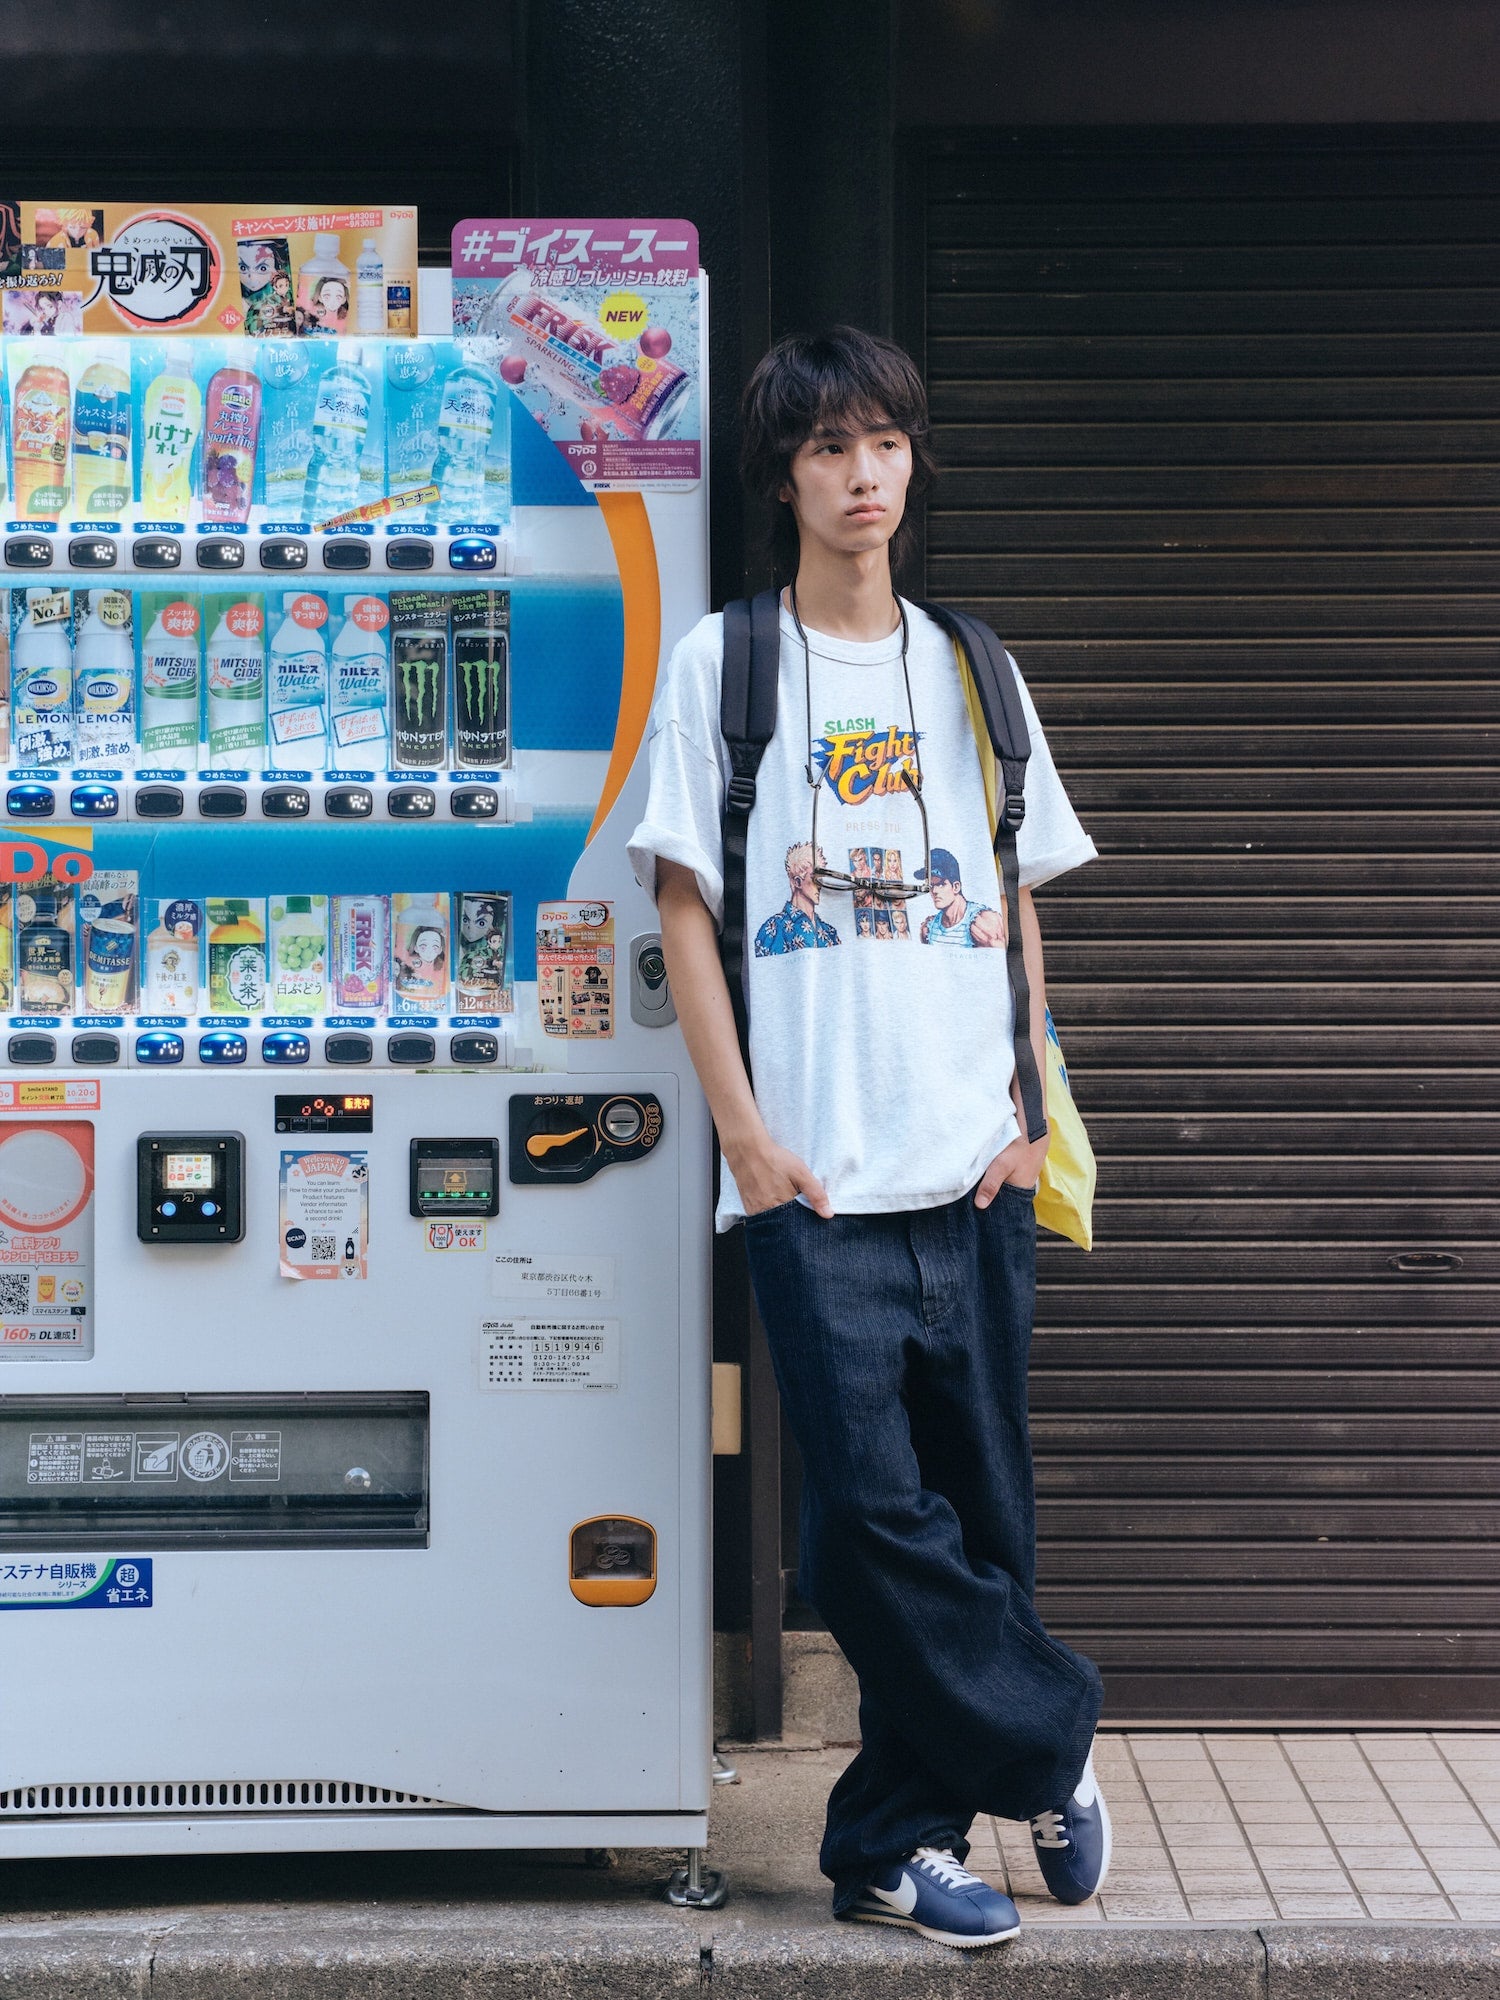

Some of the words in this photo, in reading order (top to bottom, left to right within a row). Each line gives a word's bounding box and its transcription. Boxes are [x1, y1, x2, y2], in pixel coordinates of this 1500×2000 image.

[390, 211, 414, 219] DyDo
[234, 214, 335, 235] キャンペーン実施中!
[123, 236, 194, 246] きめつのやいば
[461, 227, 689, 264] #ゴイスースー
[80, 246, 210, 309] 鬼滅の刃
[531, 268, 689, 287] 冷感リフレッシュ飲料
[606, 310, 644, 323] NEW
[518, 298, 618, 367] FRISK
[269, 351, 299, 363] 自然の
[394, 352, 425, 364] 自然の
[524, 336, 576, 372] SPARKLING
[275, 365, 296, 377] 恵み
[400, 365, 422, 377] 恵み
[319, 397, 366, 417] 天然水
[444, 398, 491, 418] 天然水
[77, 405, 128, 424] ジャスミン茶
[147, 422, 193, 444] バナナ
[207, 430, 255, 450] Sparkling
[271, 418, 286, 479] 澄んだ水
[396, 420, 409, 479] 澄んだ水
[568, 445, 597, 457] DyDo
[395, 491, 434, 508] コーナー
[391, 593, 428, 606] Unleash
[103, 611, 127, 621] No.1
[166, 609, 195, 617] スッキリ
[231, 610, 259, 618] スッキリ
[291, 611, 326, 621] すっきり!
[354, 612, 388, 623] すっきり!
[393, 611, 447, 622] モンスターエナジー
[453, 611, 507, 622] モンスターエナジー
[166, 617, 195, 631] 爽快
[231, 618, 260, 632] 爽快
[154, 656, 197, 668] MITSUYA
[220, 657, 262, 669] MITSUYA
[167, 668, 197, 678] CIDER
[232, 668, 262, 678] CIDER
[278, 664, 319, 674] カルピス
[340, 667, 380, 676] カルピス
[277, 674, 320, 688] Water
[338, 676, 381, 690] Water
[29, 682, 58, 694] WILKINSON
[88, 684, 118, 696] WILKINSON
[18, 713, 70, 724] LEMON
[78, 714, 132, 724] LEMON
[824, 717, 876, 735] SLASH
[396, 729, 445, 744] MONSTER
[457, 729, 507, 744] MONSTER
[79, 742, 130, 761] 刺激、強め
[400, 742, 441, 750] ENERGY
[461, 742, 502, 750] ENERGY
[37, 743, 72, 762] 強め。
[824, 725, 918, 782] Fight
[837, 759, 923, 806] Club
[846, 821, 881, 832] PRESS
[83, 879, 135, 891] 最高峰のコク
[541, 914, 568, 922] DyDo
[355, 911, 372, 971] FRISK
[28, 946, 60, 957] 世界一の
[89, 951, 130, 966] DEMITASSE
[156, 973, 187, 982] 午後の紅茶
[277, 982, 322, 995] 白ぶどう
[344, 1097, 370, 1110] 販売中
[533, 1095, 584, 1106] おつり・返却
[303, 1157, 335, 1165] Welcome
[305, 1162, 343, 1174] JAPAN!
[287, 1234, 305, 1243] SCAN!
[455, 1229, 482, 1237] 使えます
[11, 1236, 61, 1250] 無料アプリ
[459, 1237, 477, 1247] OK
[495, 1256, 533, 1264] ここの住所は
[521, 1272, 593, 1283] 東京都渋谷区代々木
[534, 1342, 601, 1352] 1519946
[0, 1563, 97, 1580] ステナ自販機
[119, 1567, 136, 1583] 超
[58, 1580, 87, 1589] シリーズ
[106, 1587, 149, 1603] 省エネ
